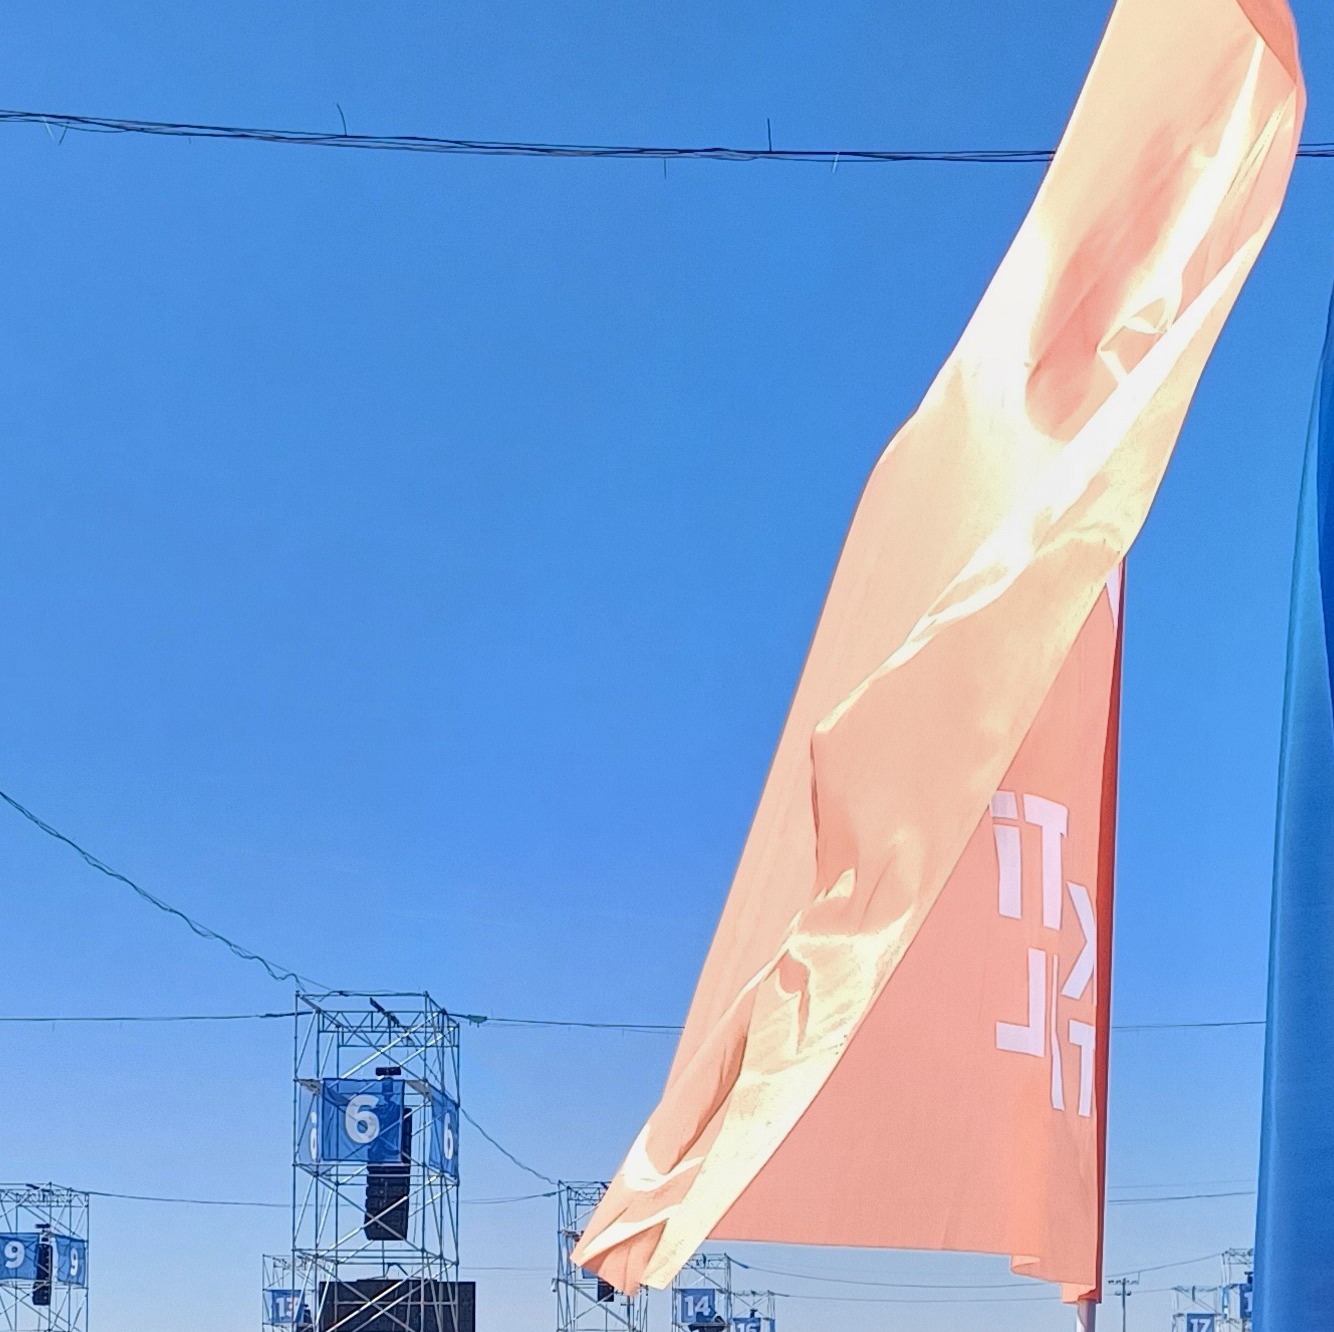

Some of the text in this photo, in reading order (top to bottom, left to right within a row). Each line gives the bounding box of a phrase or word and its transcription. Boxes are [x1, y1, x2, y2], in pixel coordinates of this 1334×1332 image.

[345, 1094, 381, 1144] 6
[4, 1241, 26, 1269] 9
[70, 1247, 79, 1277] 9
[684, 1297, 711, 1317] 14
